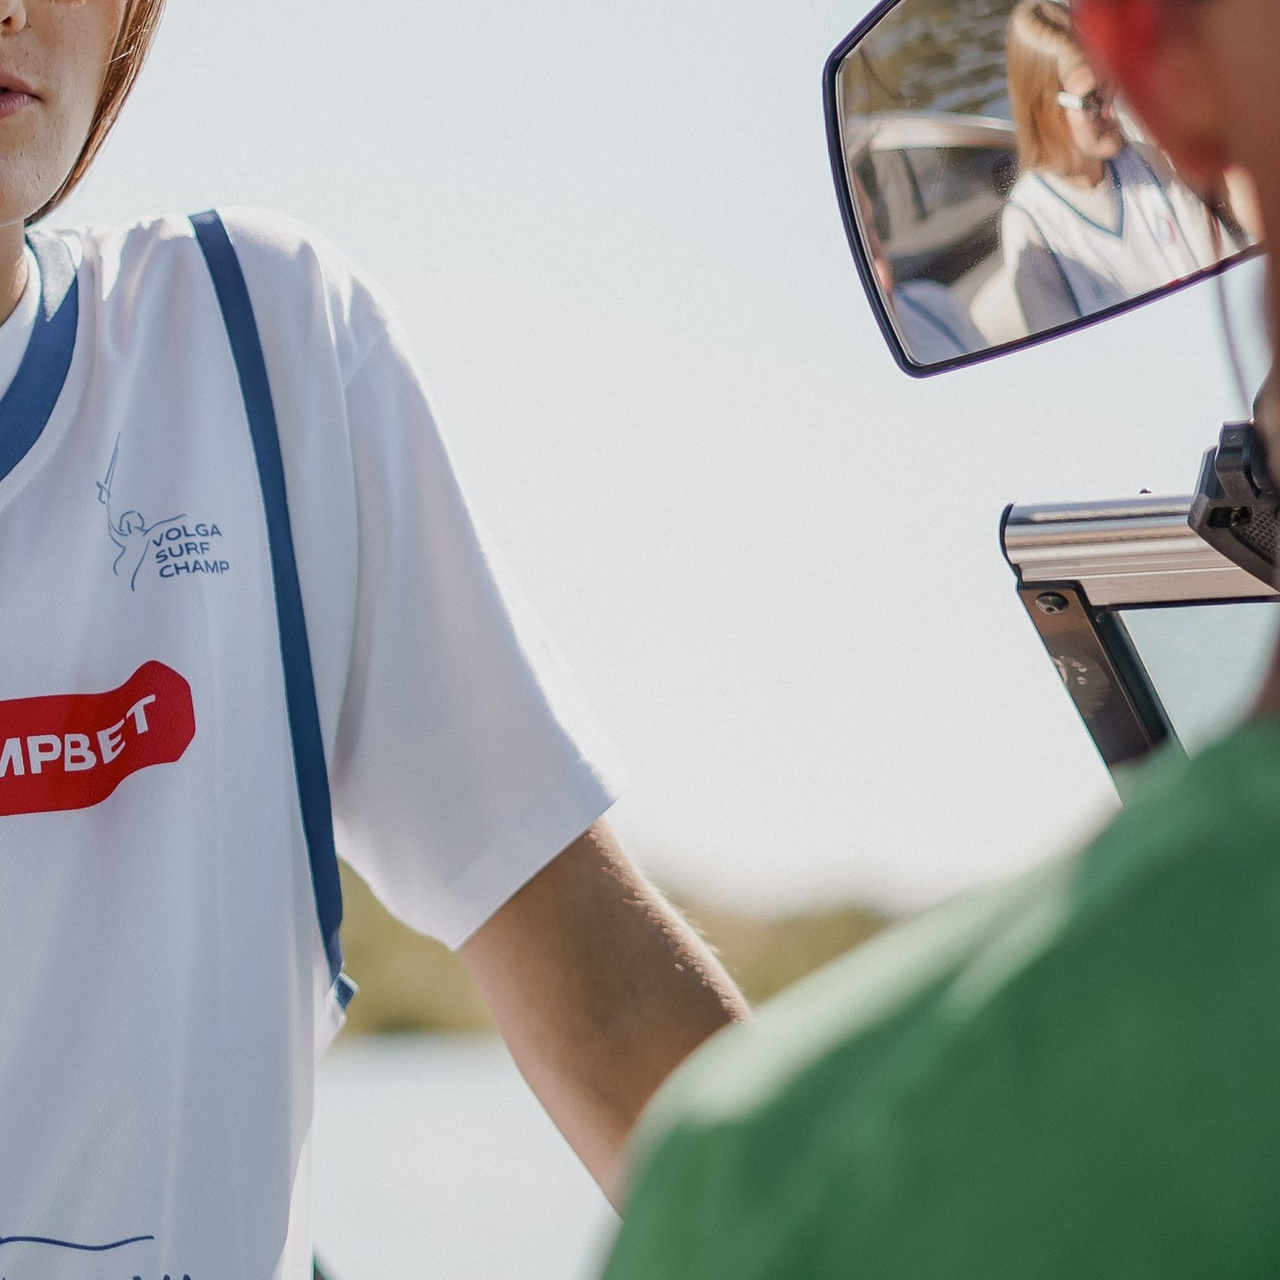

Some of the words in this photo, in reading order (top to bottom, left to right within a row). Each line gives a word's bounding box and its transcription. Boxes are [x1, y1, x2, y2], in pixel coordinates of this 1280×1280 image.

[152, 523, 222, 547] VOLGA
[155, 542, 210, 564] SURF
[158, 560, 230, 578] CHAMP
